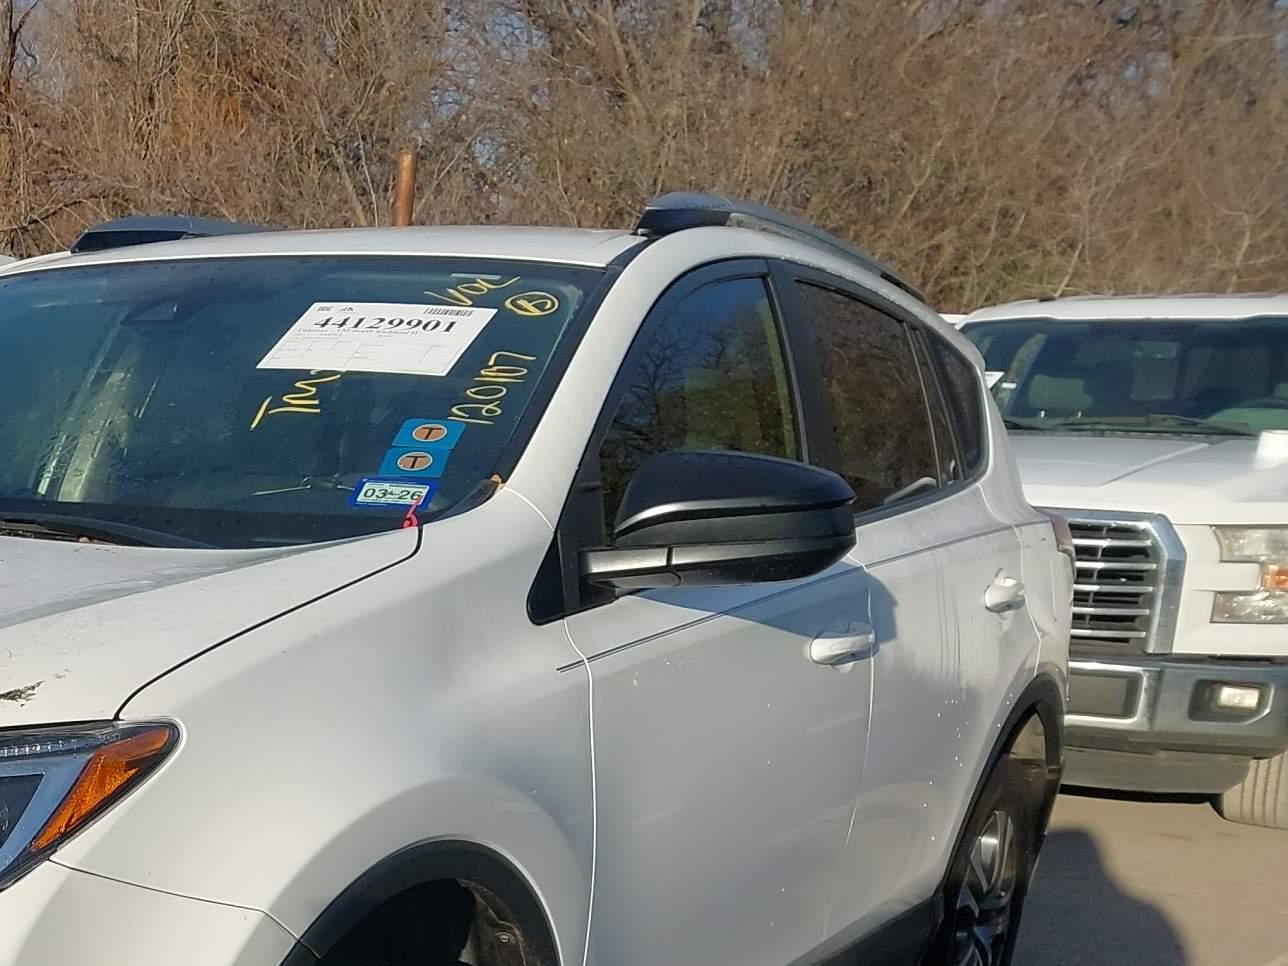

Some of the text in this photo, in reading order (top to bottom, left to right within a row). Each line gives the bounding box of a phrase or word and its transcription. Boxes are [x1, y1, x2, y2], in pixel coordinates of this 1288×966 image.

[313, 316, 459, 333] 44129901
[422, 426, 443, 441] T
[407, 455, 427, 469] T
[363, 488, 388, 499] 03
[397, 489, 423, 501] 26
